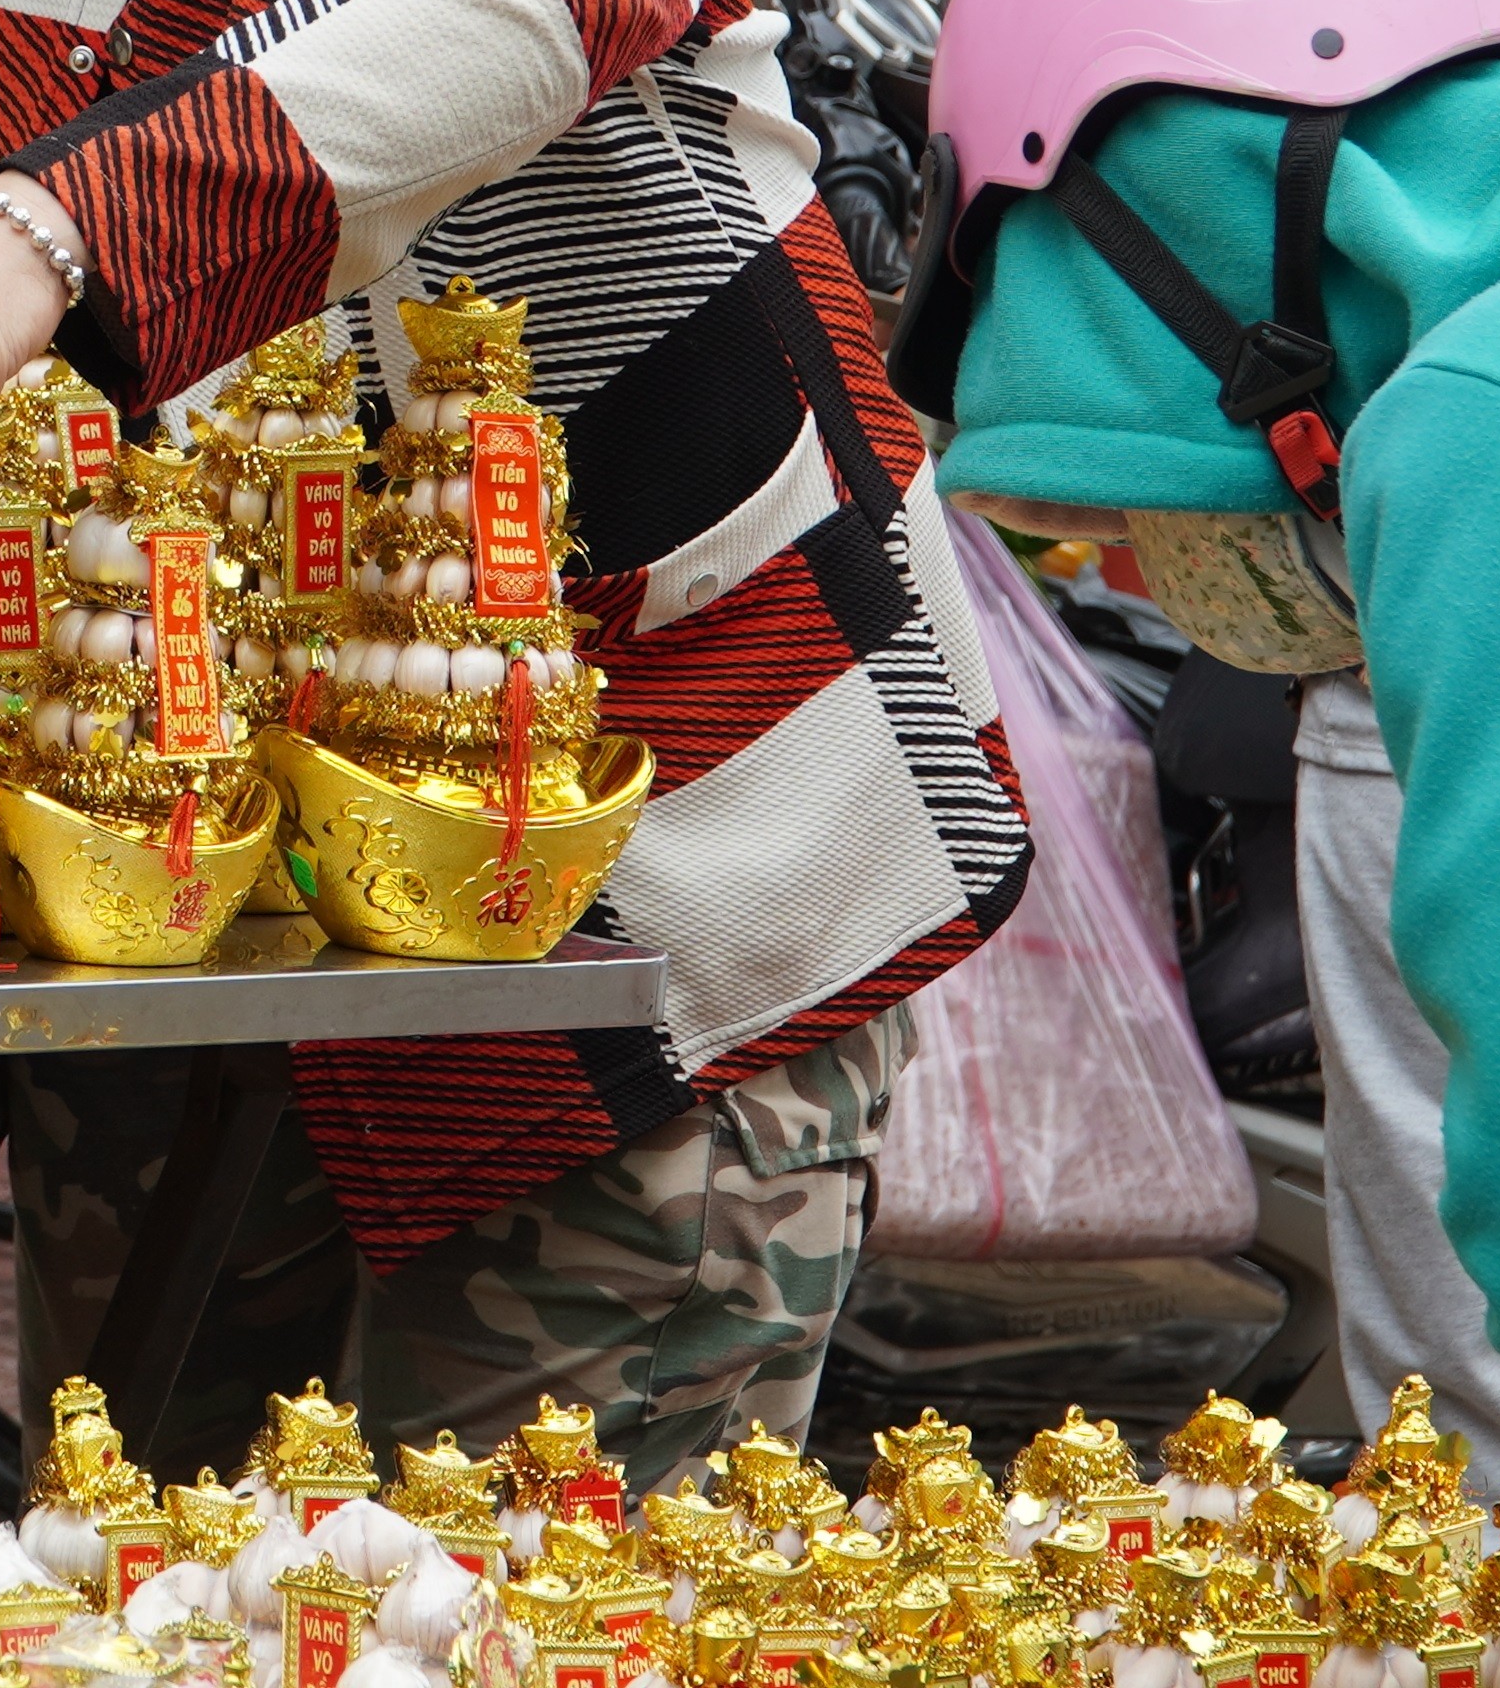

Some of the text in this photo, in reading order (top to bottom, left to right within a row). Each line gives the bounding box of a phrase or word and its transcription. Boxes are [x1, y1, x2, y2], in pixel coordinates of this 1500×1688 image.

[79, 423, 104, 440] AN
[76, 448, 112, 467] KHANG
[490, 461, 528, 485] Tiền
[305, 480, 342, 502] VÀNG
[495, 488, 518, 510] Vô
[313, 509, 333, 529] VÔ
[492, 516, 528, 540] Như
[308, 534, 336, 558] ĐẦY
[490, 541, 537, 567] Nước
[1, 567, 22, 588] VÔ
[307, 564, 338, 585] NHÀ
[0, 620, 31, 643] NHÀ
[166, 624, 202, 657] TIỀN
[178, 658, 200, 684] VÔ
[174, 681, 206, 710] NHƯ
[171, 709, 211, 736] NƯỚC
[476, 865, 535, 929] 福
[1118, 1530, 1143, 1550] AN
[126, 1556, 163, 1582] CHÚC
[303, 1612, 344, 1647] VÀNG
[613, 1619, 643, 1647] CHÚ
[617, 1650, 650, 1680] MỪN
[1259, 1659, 1298, 1686] CHÚC
